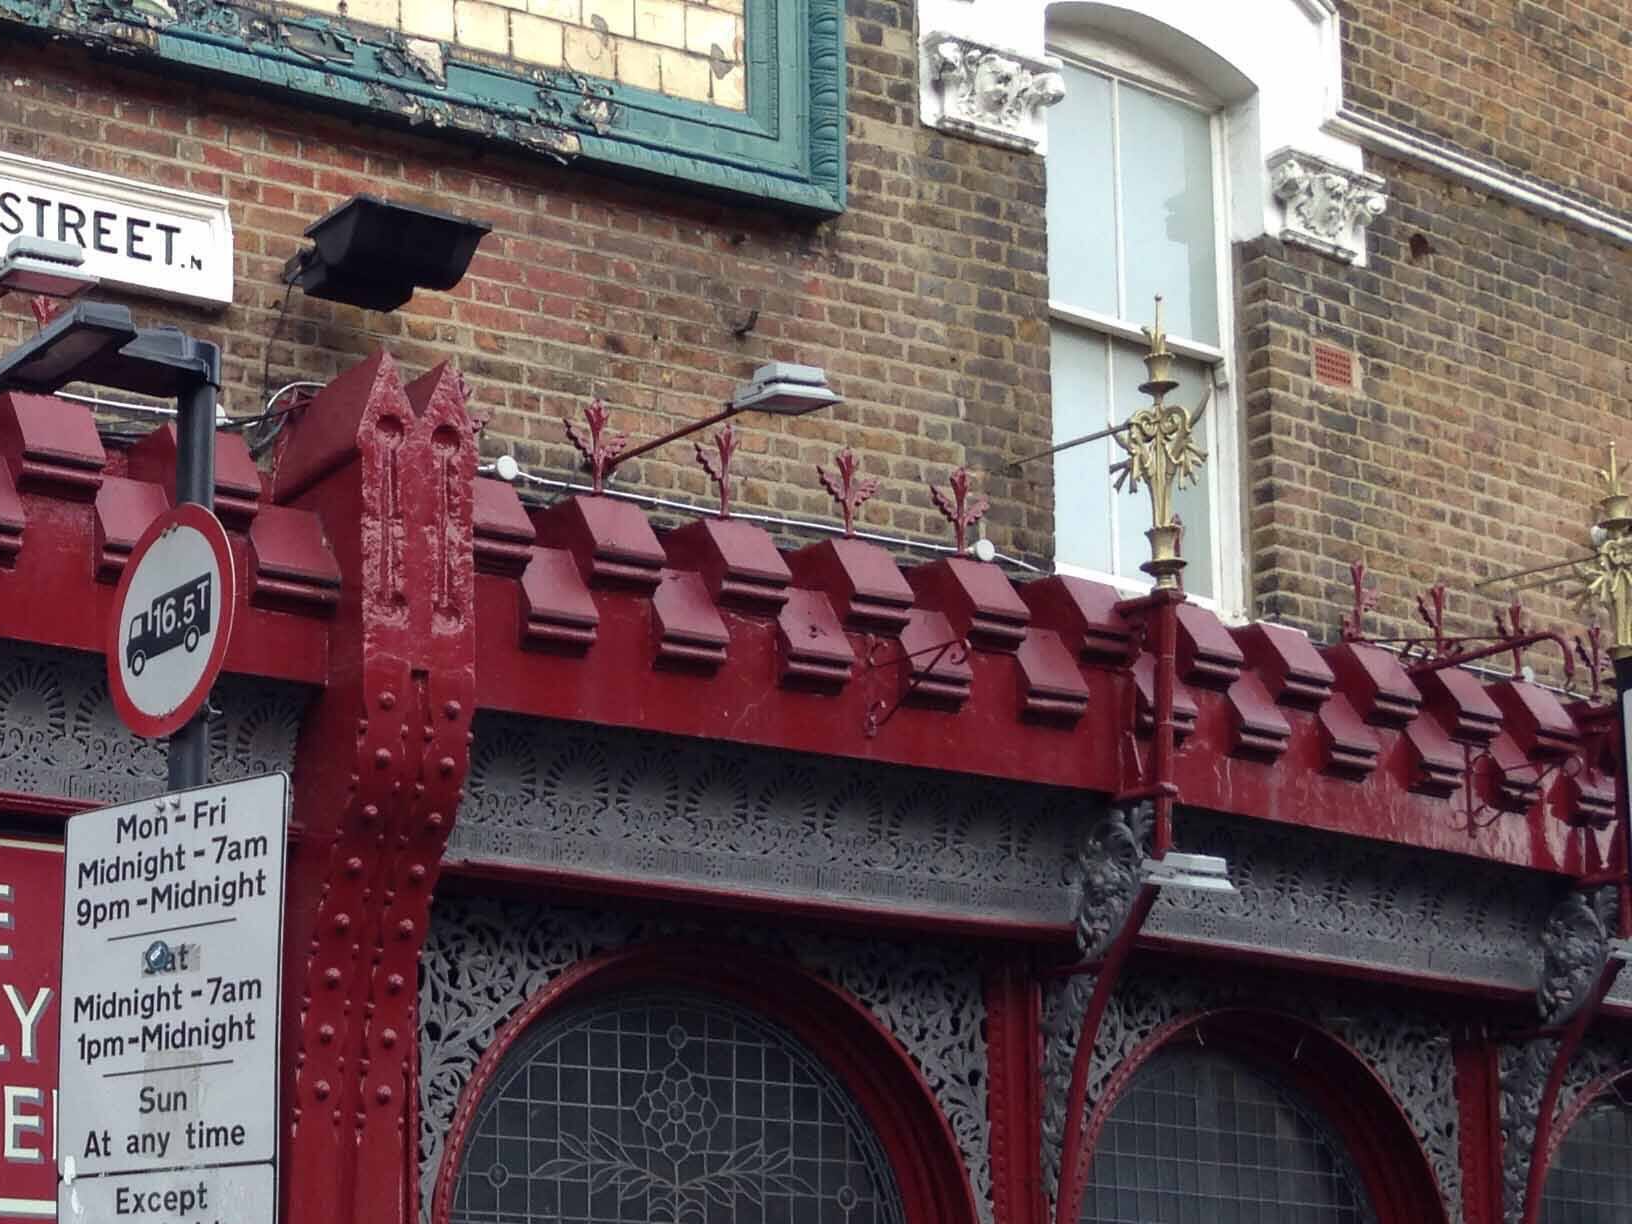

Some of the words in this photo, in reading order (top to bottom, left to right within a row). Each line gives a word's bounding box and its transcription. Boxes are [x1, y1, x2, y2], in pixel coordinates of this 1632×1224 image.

[116, 815, 167, 844] Mon
[193, 797, 227, 830] Fri
[77, 846, 186, 889] Midnight
[213, 834, 268, 864] 7am
[76, 897, 130, 930] 9pm
[73, 985, 182, 1024] Midnight
[208, 977, 262, 1007] 7am
[138, 1086, 188, 1115] Sun
[84, 1130, 111, 1159] At
[126, 1130, 171, 1159] any
[185, 1121, 246, 1150] time
[115, 1182, 209, 1216] Except
